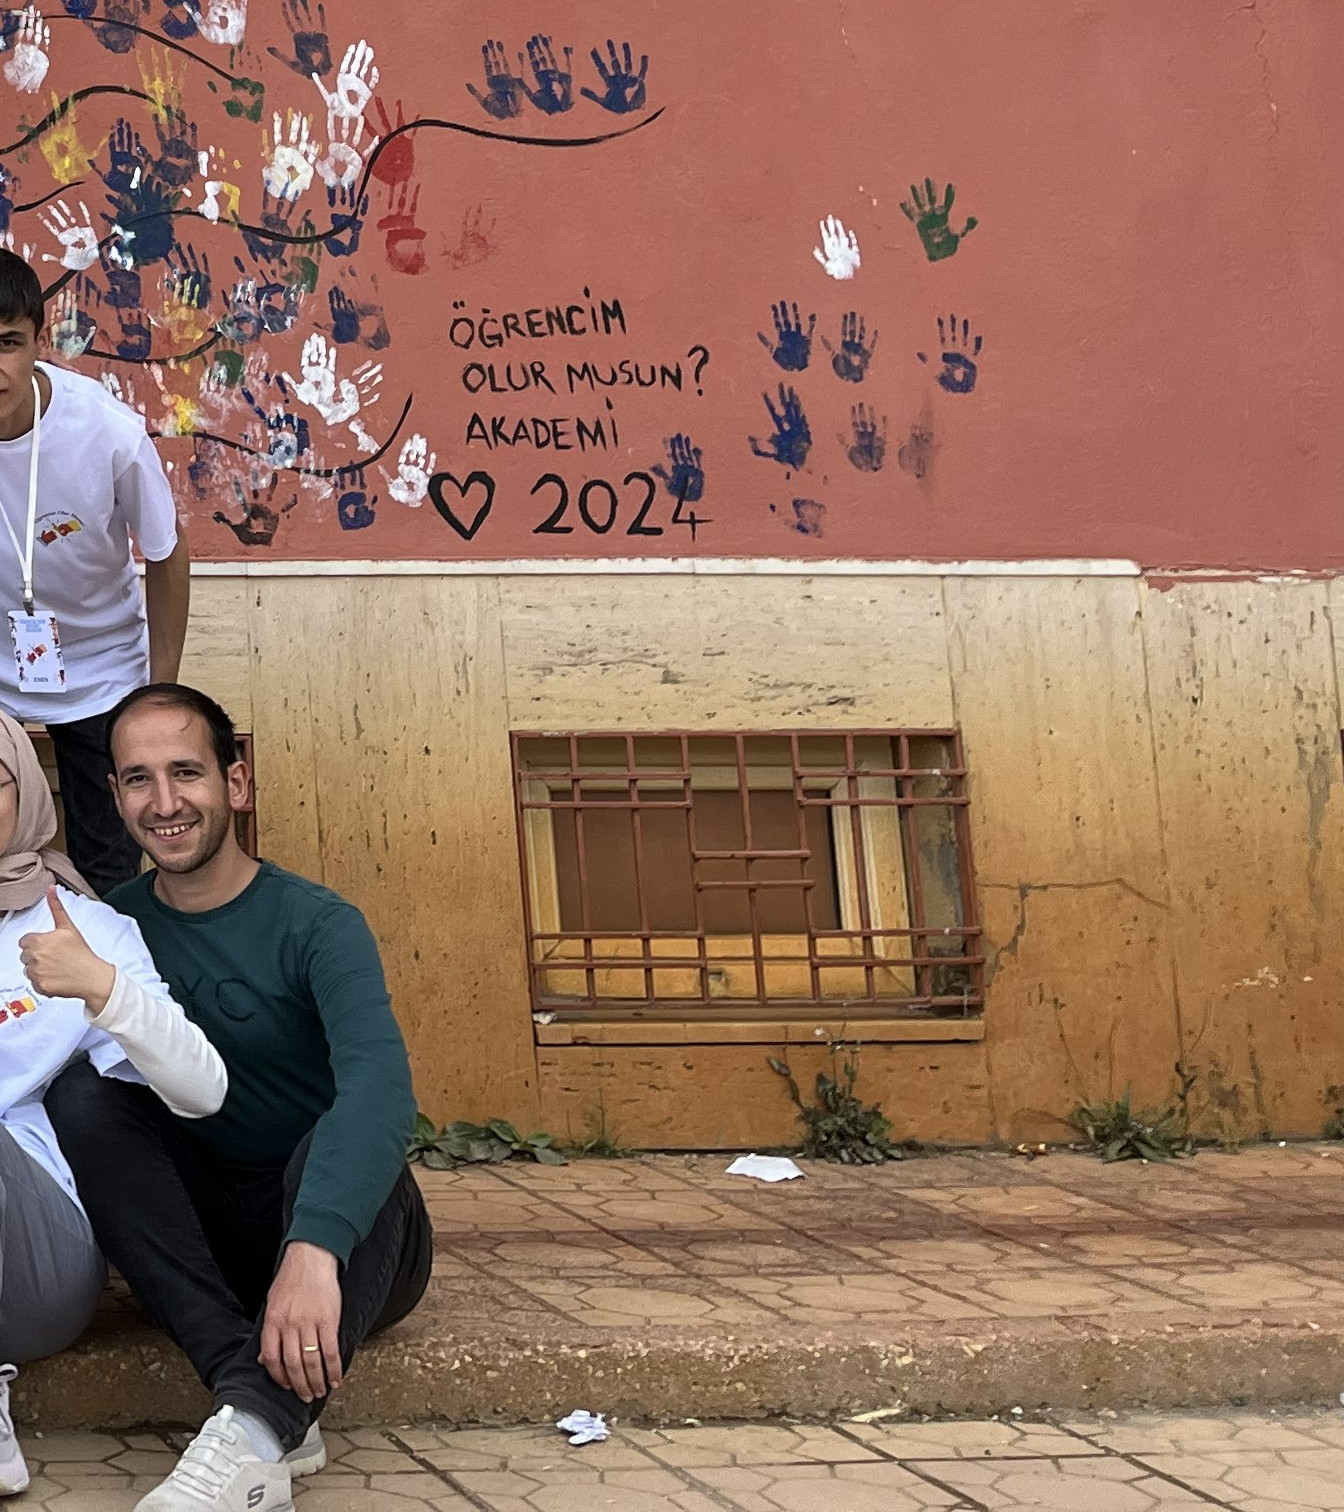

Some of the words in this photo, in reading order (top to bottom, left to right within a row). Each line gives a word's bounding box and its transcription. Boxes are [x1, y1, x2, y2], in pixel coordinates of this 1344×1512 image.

[462, 361, 556, 394] OLUR
[566, 344, 710, 396] MUSUN?
[465, 397, 620, 451] AKADEMİ
[530, 471, 714, 542] 2024
